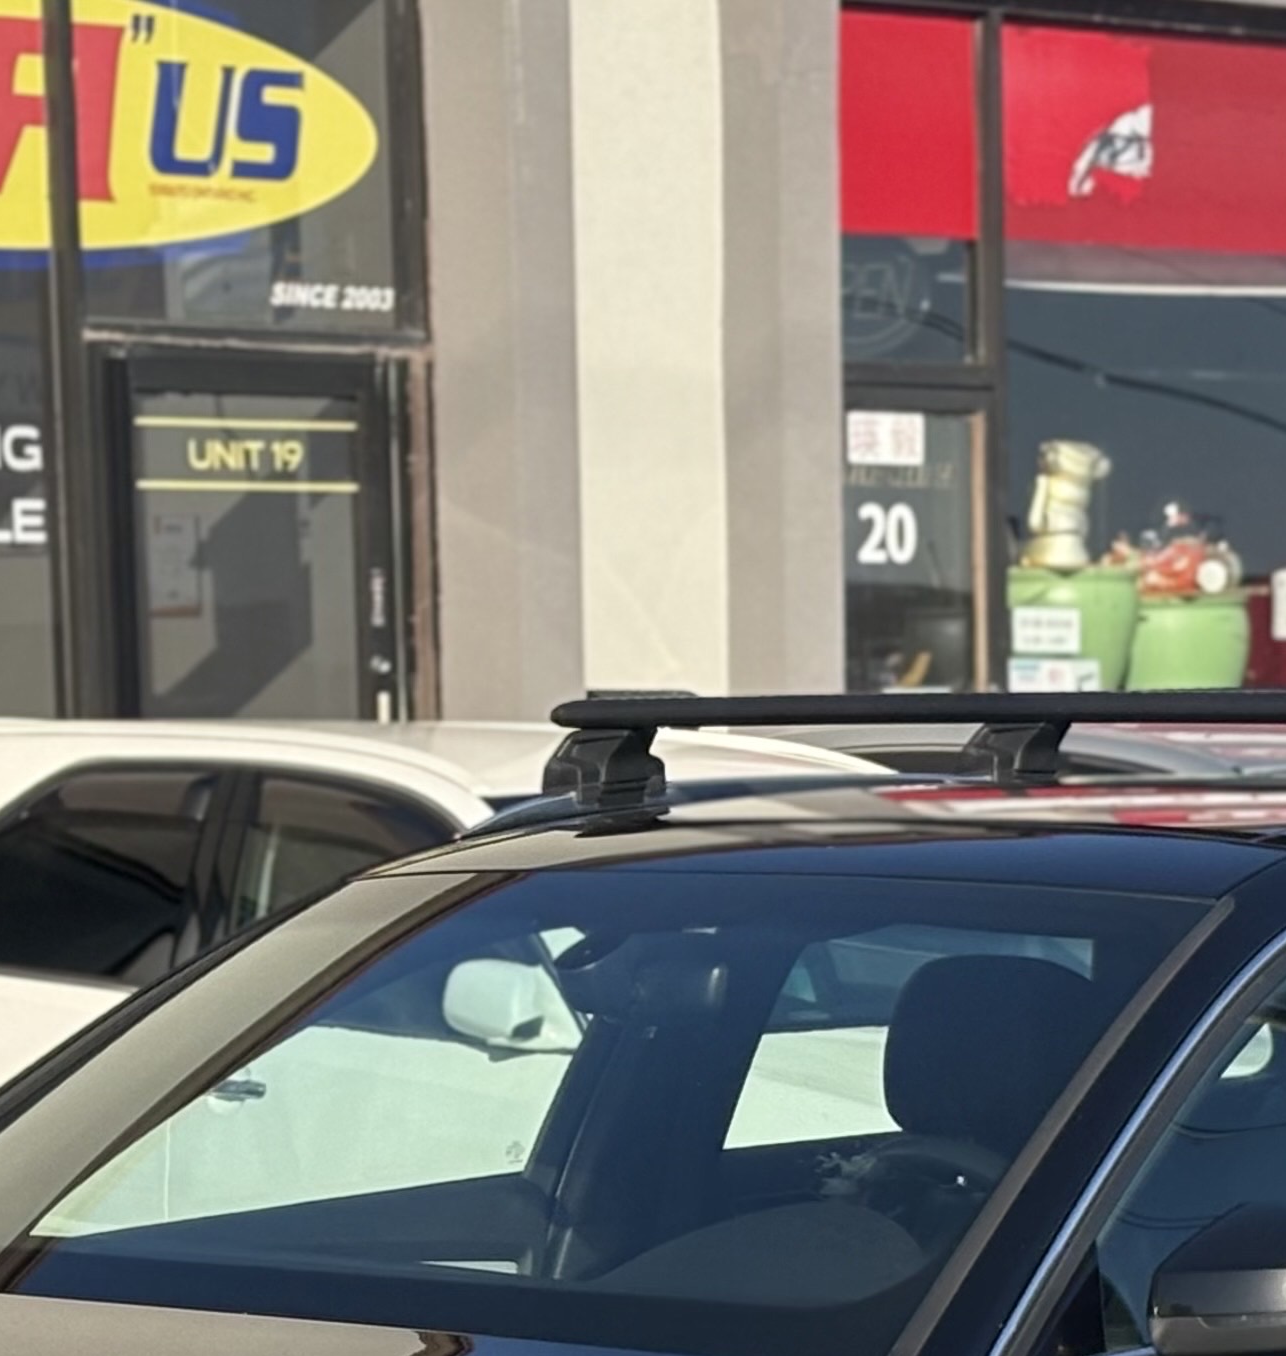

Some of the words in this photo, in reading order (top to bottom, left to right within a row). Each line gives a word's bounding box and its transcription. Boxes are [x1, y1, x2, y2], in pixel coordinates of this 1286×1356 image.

[148, 59, 305, 182] US
[269, 280, 339, 309] SINCE
[341, 284, 396, 313] 2003
[187, 438, 264, 471] UNIT
[270, 440, 305, 472] 19
[857, 500, 918, 565] 20
